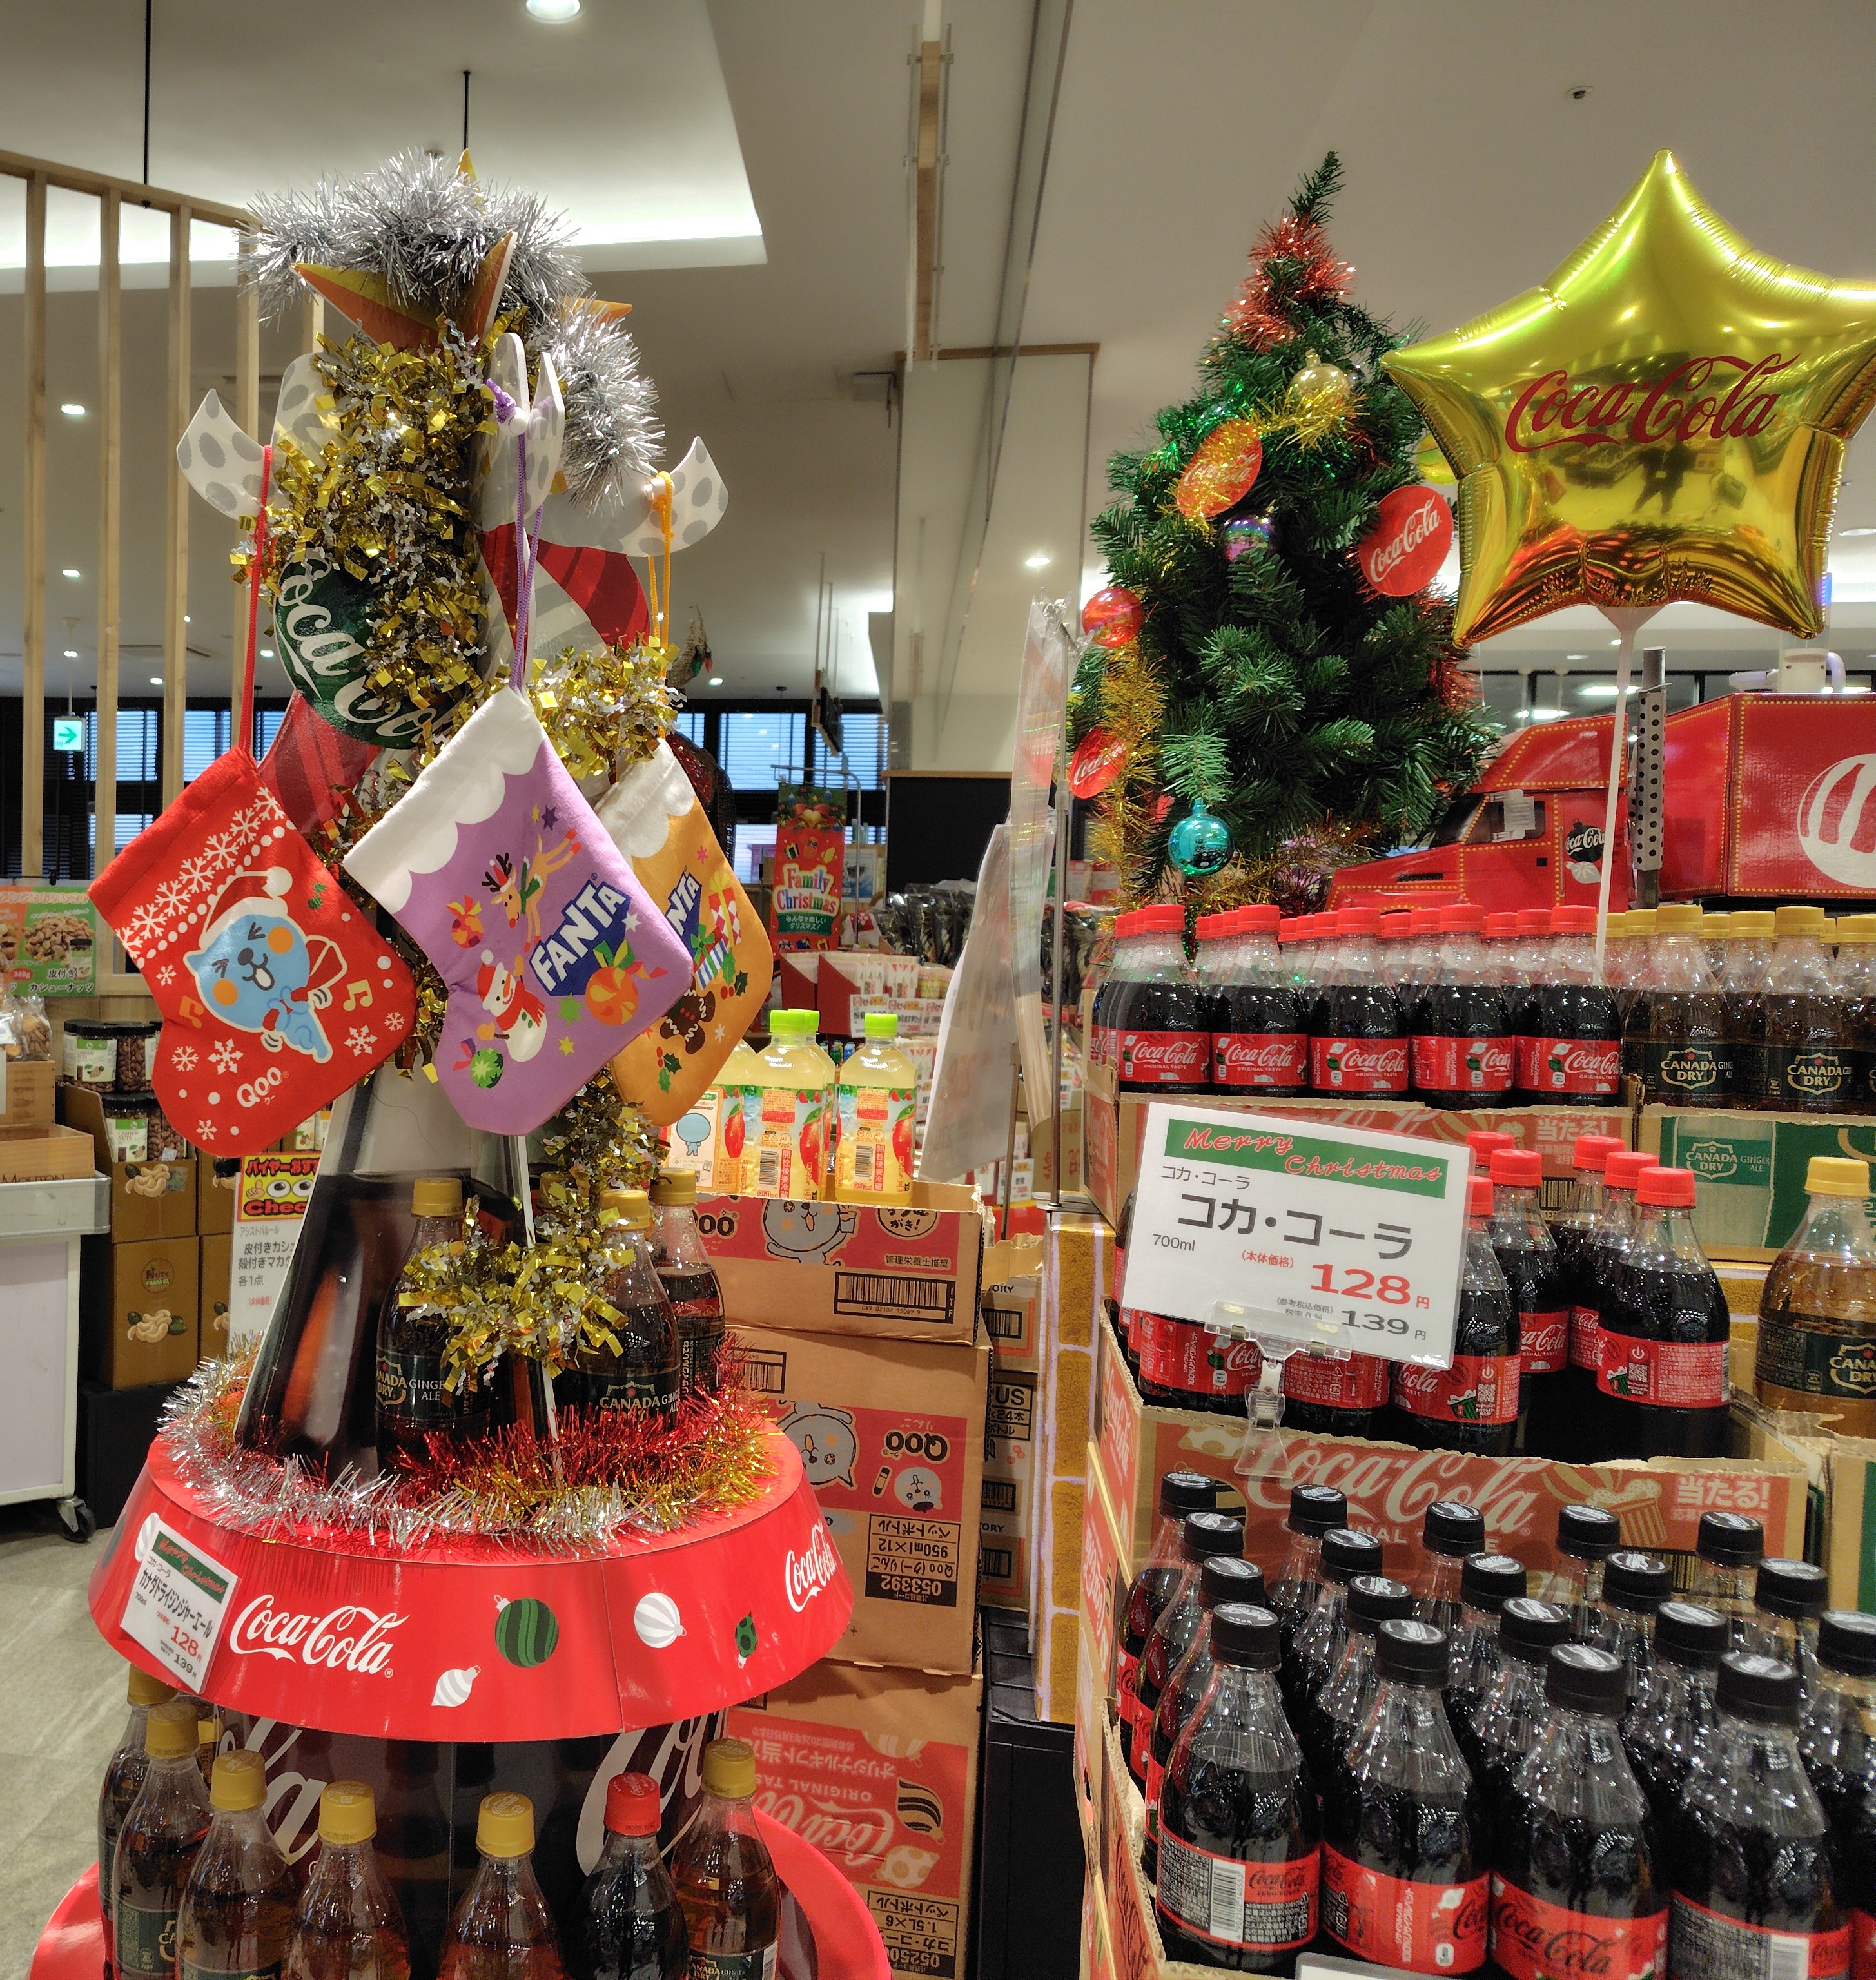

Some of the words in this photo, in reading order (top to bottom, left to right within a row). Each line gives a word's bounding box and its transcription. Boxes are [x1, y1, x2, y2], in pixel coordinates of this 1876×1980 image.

[1505, 353, 1802, 452] Coca-Cola
[1369, 498, 1441, 583] Coca-Cola
[787, 868, 831, 894] Family
[776, 889, 837, 914] Christmas
[531, 883, 627, 992] FANTA
[48, 968, 77, 980] 皮付き
[30, 983, 95, 993] カシューナッツ
[1131, 1040, 1199, 1064] Coca-Cola
[1225, 1043, 1296, 1067] Coca-Cola
[1340, 1049, 1407, 1072] Coca-Cola
[1661, 1060, 1717, 1071] CANADA
[1677, 1071, 1704, 1080] DRY
[1787, 1065, 1842, 1076] CANADA
[237, 1067, 283, 1108] Qoo
[1804, 1076, 1831, 1086] DRY
[1184, 1127, 1293, 1156] Merry
[1285, 1155, 1443, 1182] Christmas
[1685, 1152, 1738, 1163] CANADA
[1740, 1155, 1770, 1165] GINGER
[1699, 1162, 1724, 1172] DRY
[1750, 1164, 1764, 1173] ALE
[1160, 1165, 1251, 1191] コカ・コーラ
[243, 1199, 307, 1216] Chec
[696, 1214, 735, 1236] oo
[1178, 1192, 1413, 1260] コカ・コーラ
[1152, 1233, 1195, 1253] 700ml
[884, 1254, 949, 1268] 管理栄養士推奨
[1242, 1249, 1294, 1269] （本体価格）
[239, 1275, 264, 1287] 各1点
[1311, 1263, 1411, 1305] 128
[1416, 1296, 1431, 1310] 円
[1342, 1310, 1410, 1335] 139
[1414, 1329, 1427, 1341] 円
[409, 1379, 445, 1390] GINGE
[420, 1390, 441, 1401] ALE
[599, 1396, 660, 1410] CANADA
[899, 1417, 935, 1432] りんご
[885, 1431, 948, 1462] Qoo
[1677, 1475, 1771, 1510] 当たる!
[877, 1519, 951, 1538] ペットボトル
[147, 1555, 171, 1578] コカ・コーラ
[785, 1519, 837, 1613] Coca-Cola
[881, 1575, 942, 1596] 053392
[139, 1568, 213, 1639] カナダドライジンジャーエール
[170, 1625, 199, 1658] 128
[230, 1594, 411, 1674] Coca-Cola
[173, 1653, 193, 1674] 139
[788, 1779, 872, 1802] ORIGINAL
[875, 1896, 950, 1917] ペットボトル
[884, 1930, 951, 1952] コカ・コー
[884, 1946, 941, 1969] 05250
